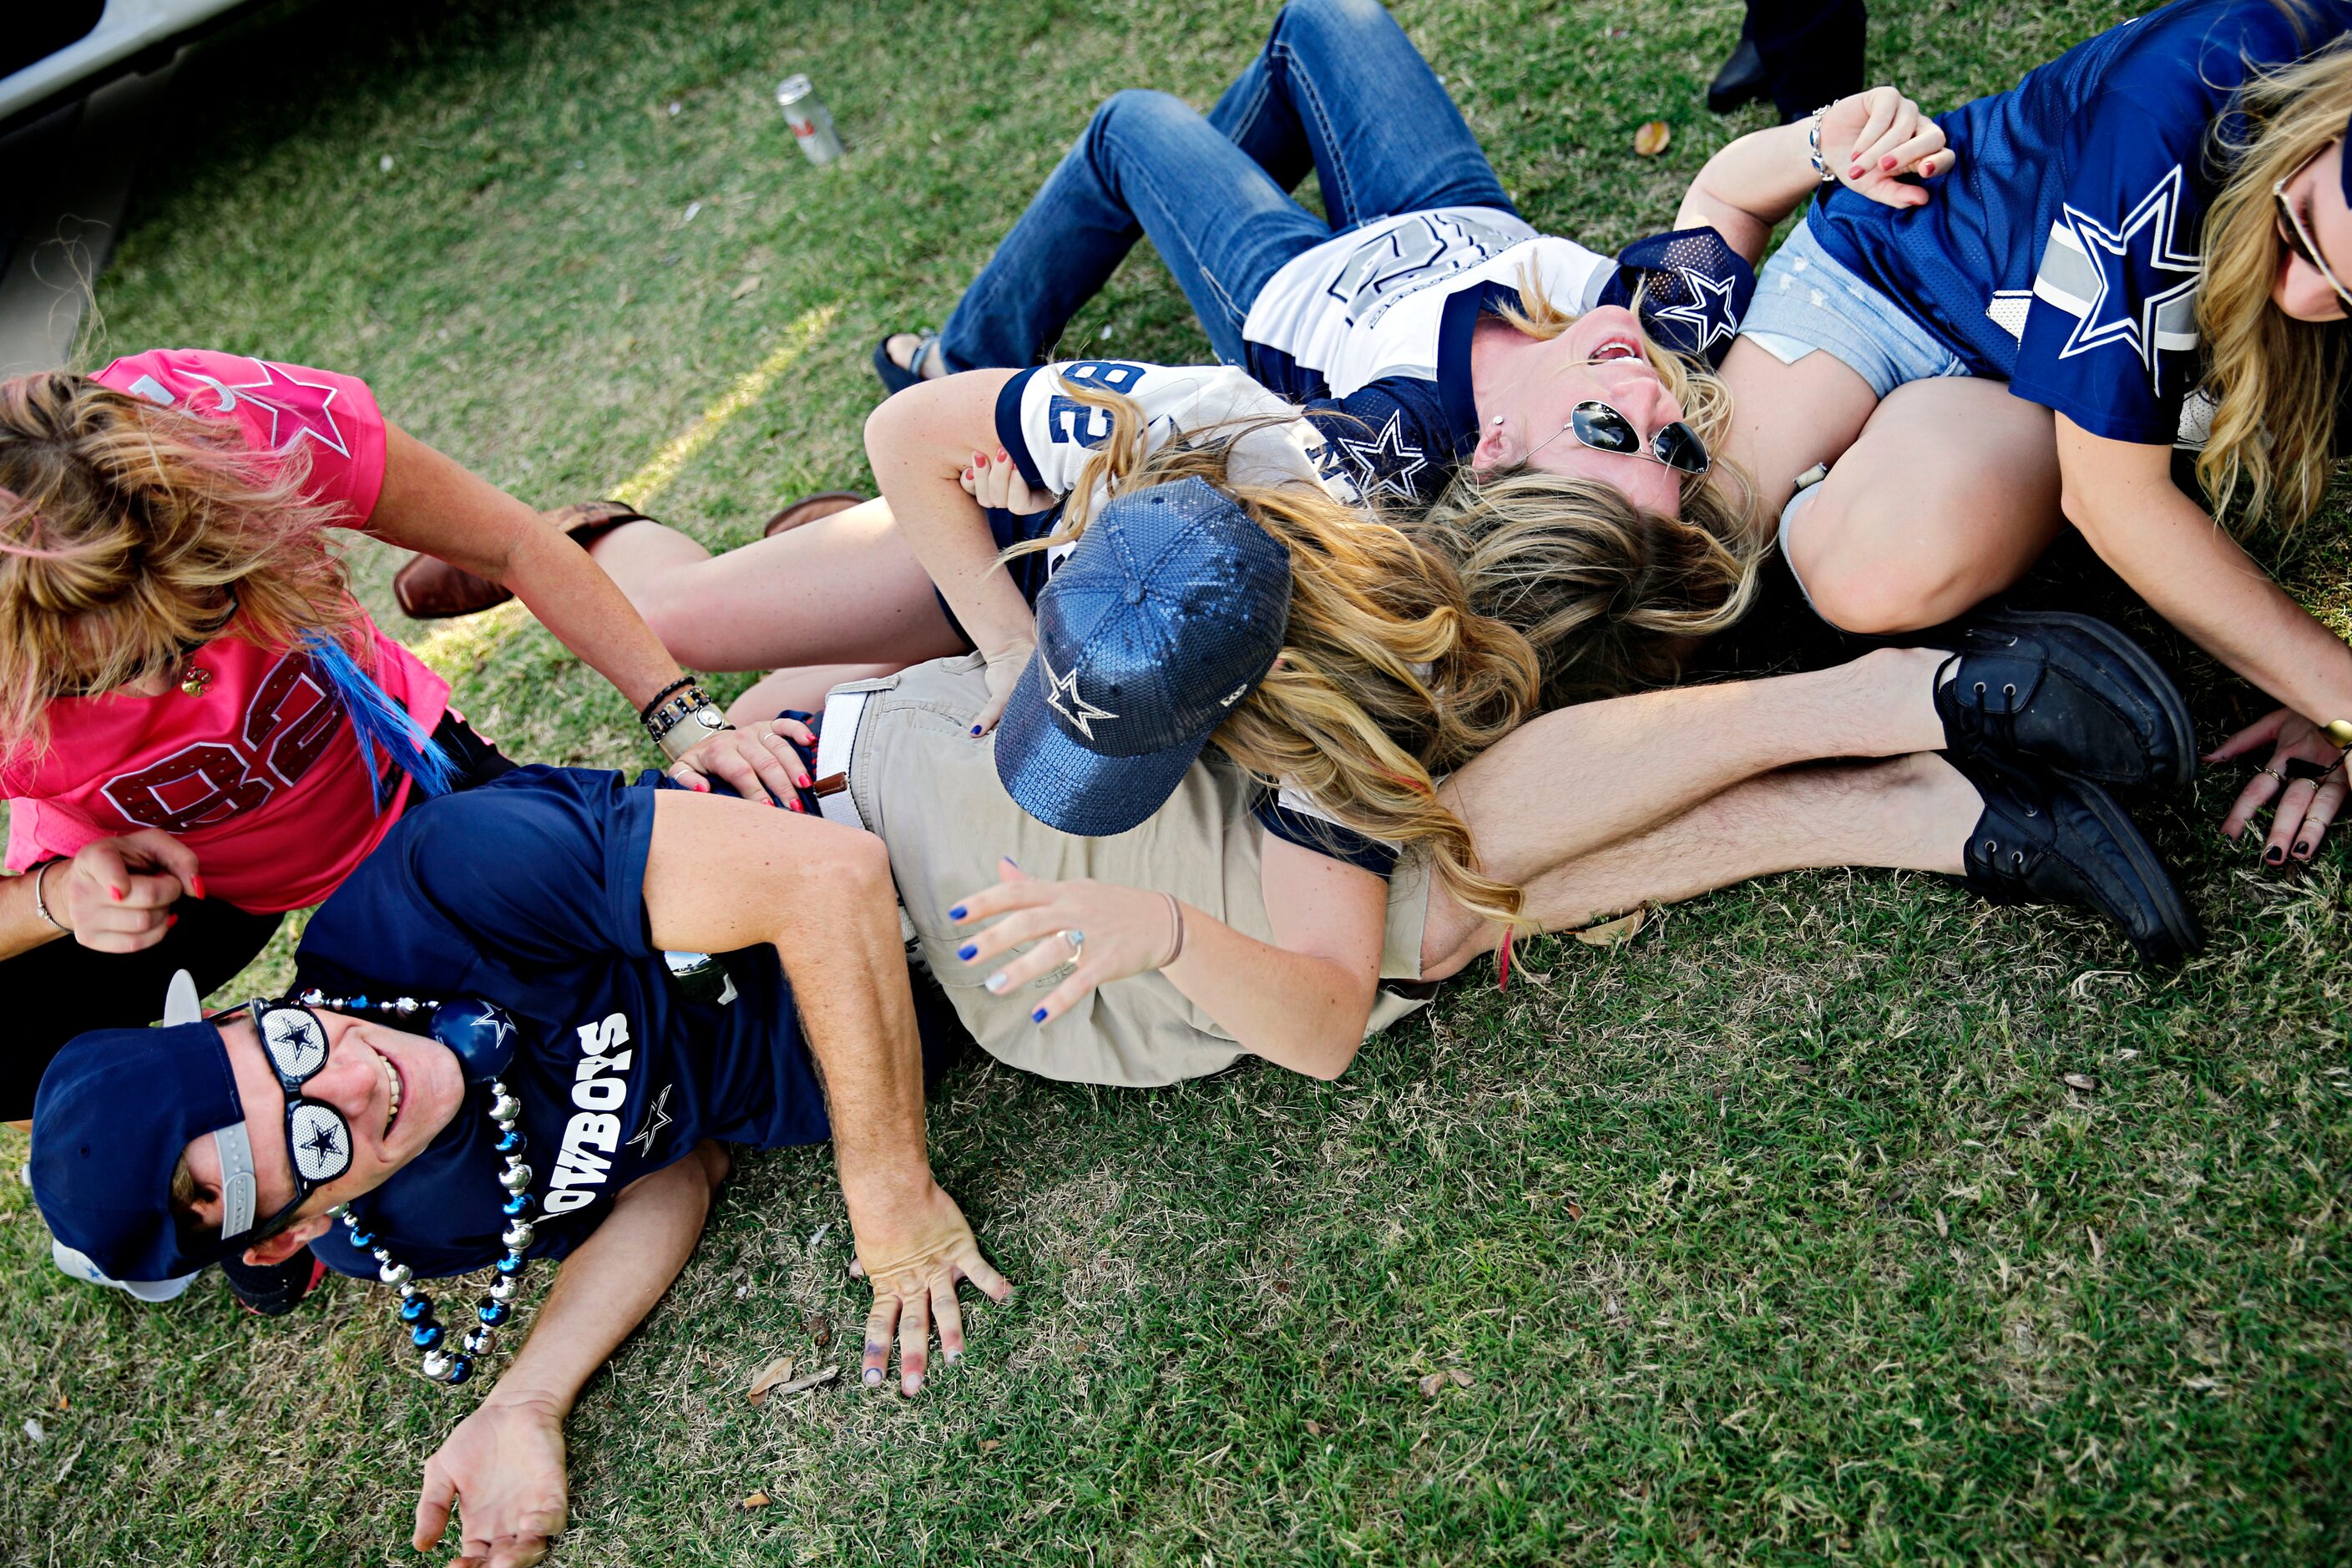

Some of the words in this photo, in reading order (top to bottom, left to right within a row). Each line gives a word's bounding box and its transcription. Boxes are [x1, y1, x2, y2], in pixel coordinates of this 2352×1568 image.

[1049, 362, 1146, 451] 82
[100, 650, 346, 834] 82
[532, 1013, 633, 1224] OWBOYS
